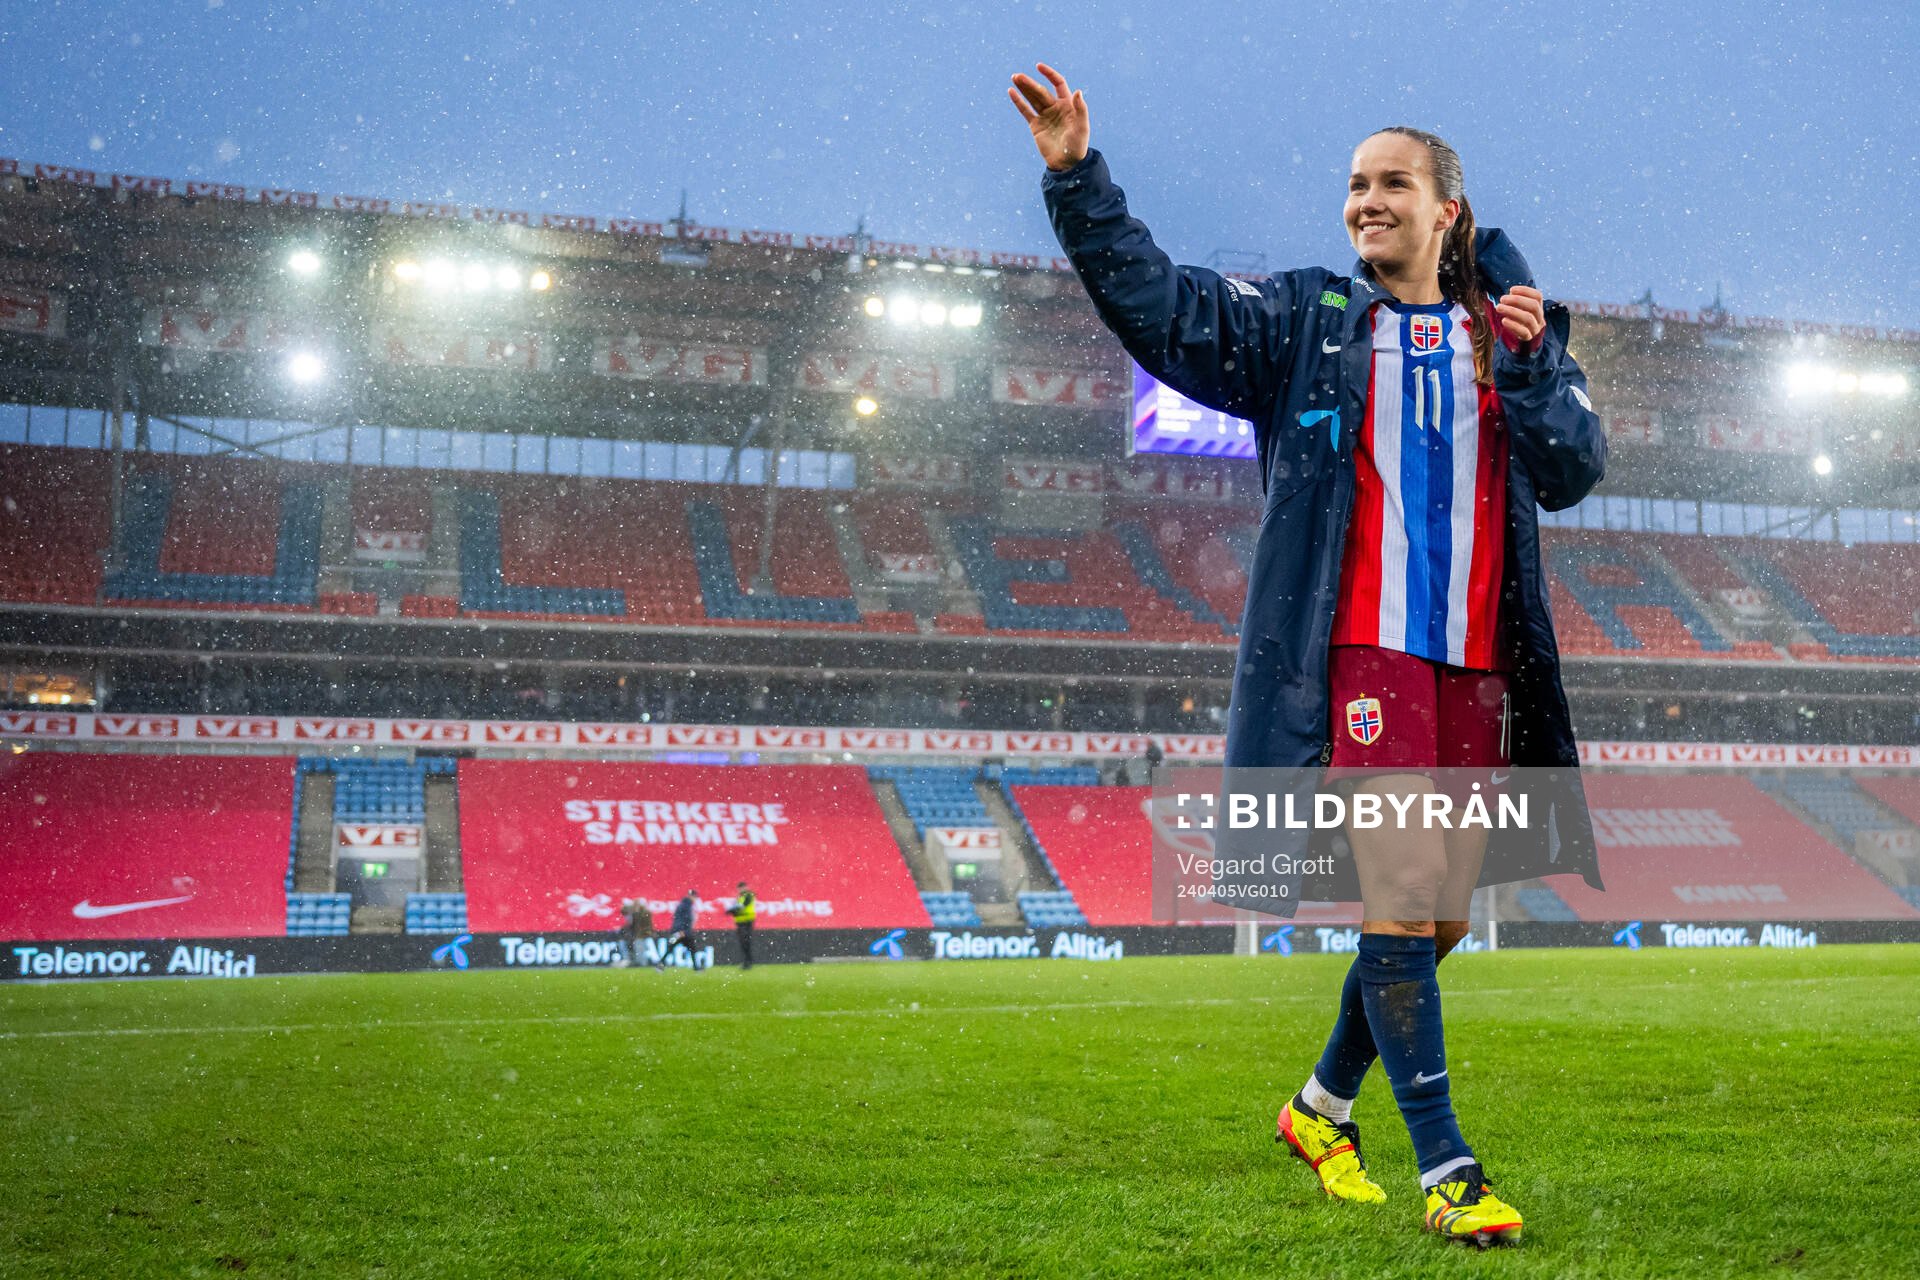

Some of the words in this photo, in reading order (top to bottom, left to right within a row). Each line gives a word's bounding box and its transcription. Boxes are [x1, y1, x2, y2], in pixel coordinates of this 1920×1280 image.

[1320, 290, 1348, 311] KIW
[1412, 366, 1442, 432] 11
[94, 717, 178, 737] VG
[196, 719, 278, 738] VG
[295, 720, 375, 740] VG
[392, 722, 469, 741] VG
[486, 724, 561, 743] VG
[578, 725, 651, 745] VG
[668, 727, 739, 746] VG
[756, 728, 826, 748] VG
[840, 731, 909, 750] VG
[924, 733, 993, 750] VG
[1007, 734, 1073, 752] VG
[1087, 735, 1150, 753] VG
[1600, 743, 1657, 761] VG
[1667, 745, 1722, 762] VG
[1796, 747, 1849, 763] VG
[564, 800, 790, 824] STERKERE
[340, 826, 421, 847] VG
[583, 821, 779, 845] SAMMEN
[934, 829, 1003, 848] VG
[930, 932, 1041, 959] Telenor.
[1660, 923, 1752, 948] Telenor.
[13, 946, 151, 976] Telenor.
[500, 937, 622, 966] Telenor.
